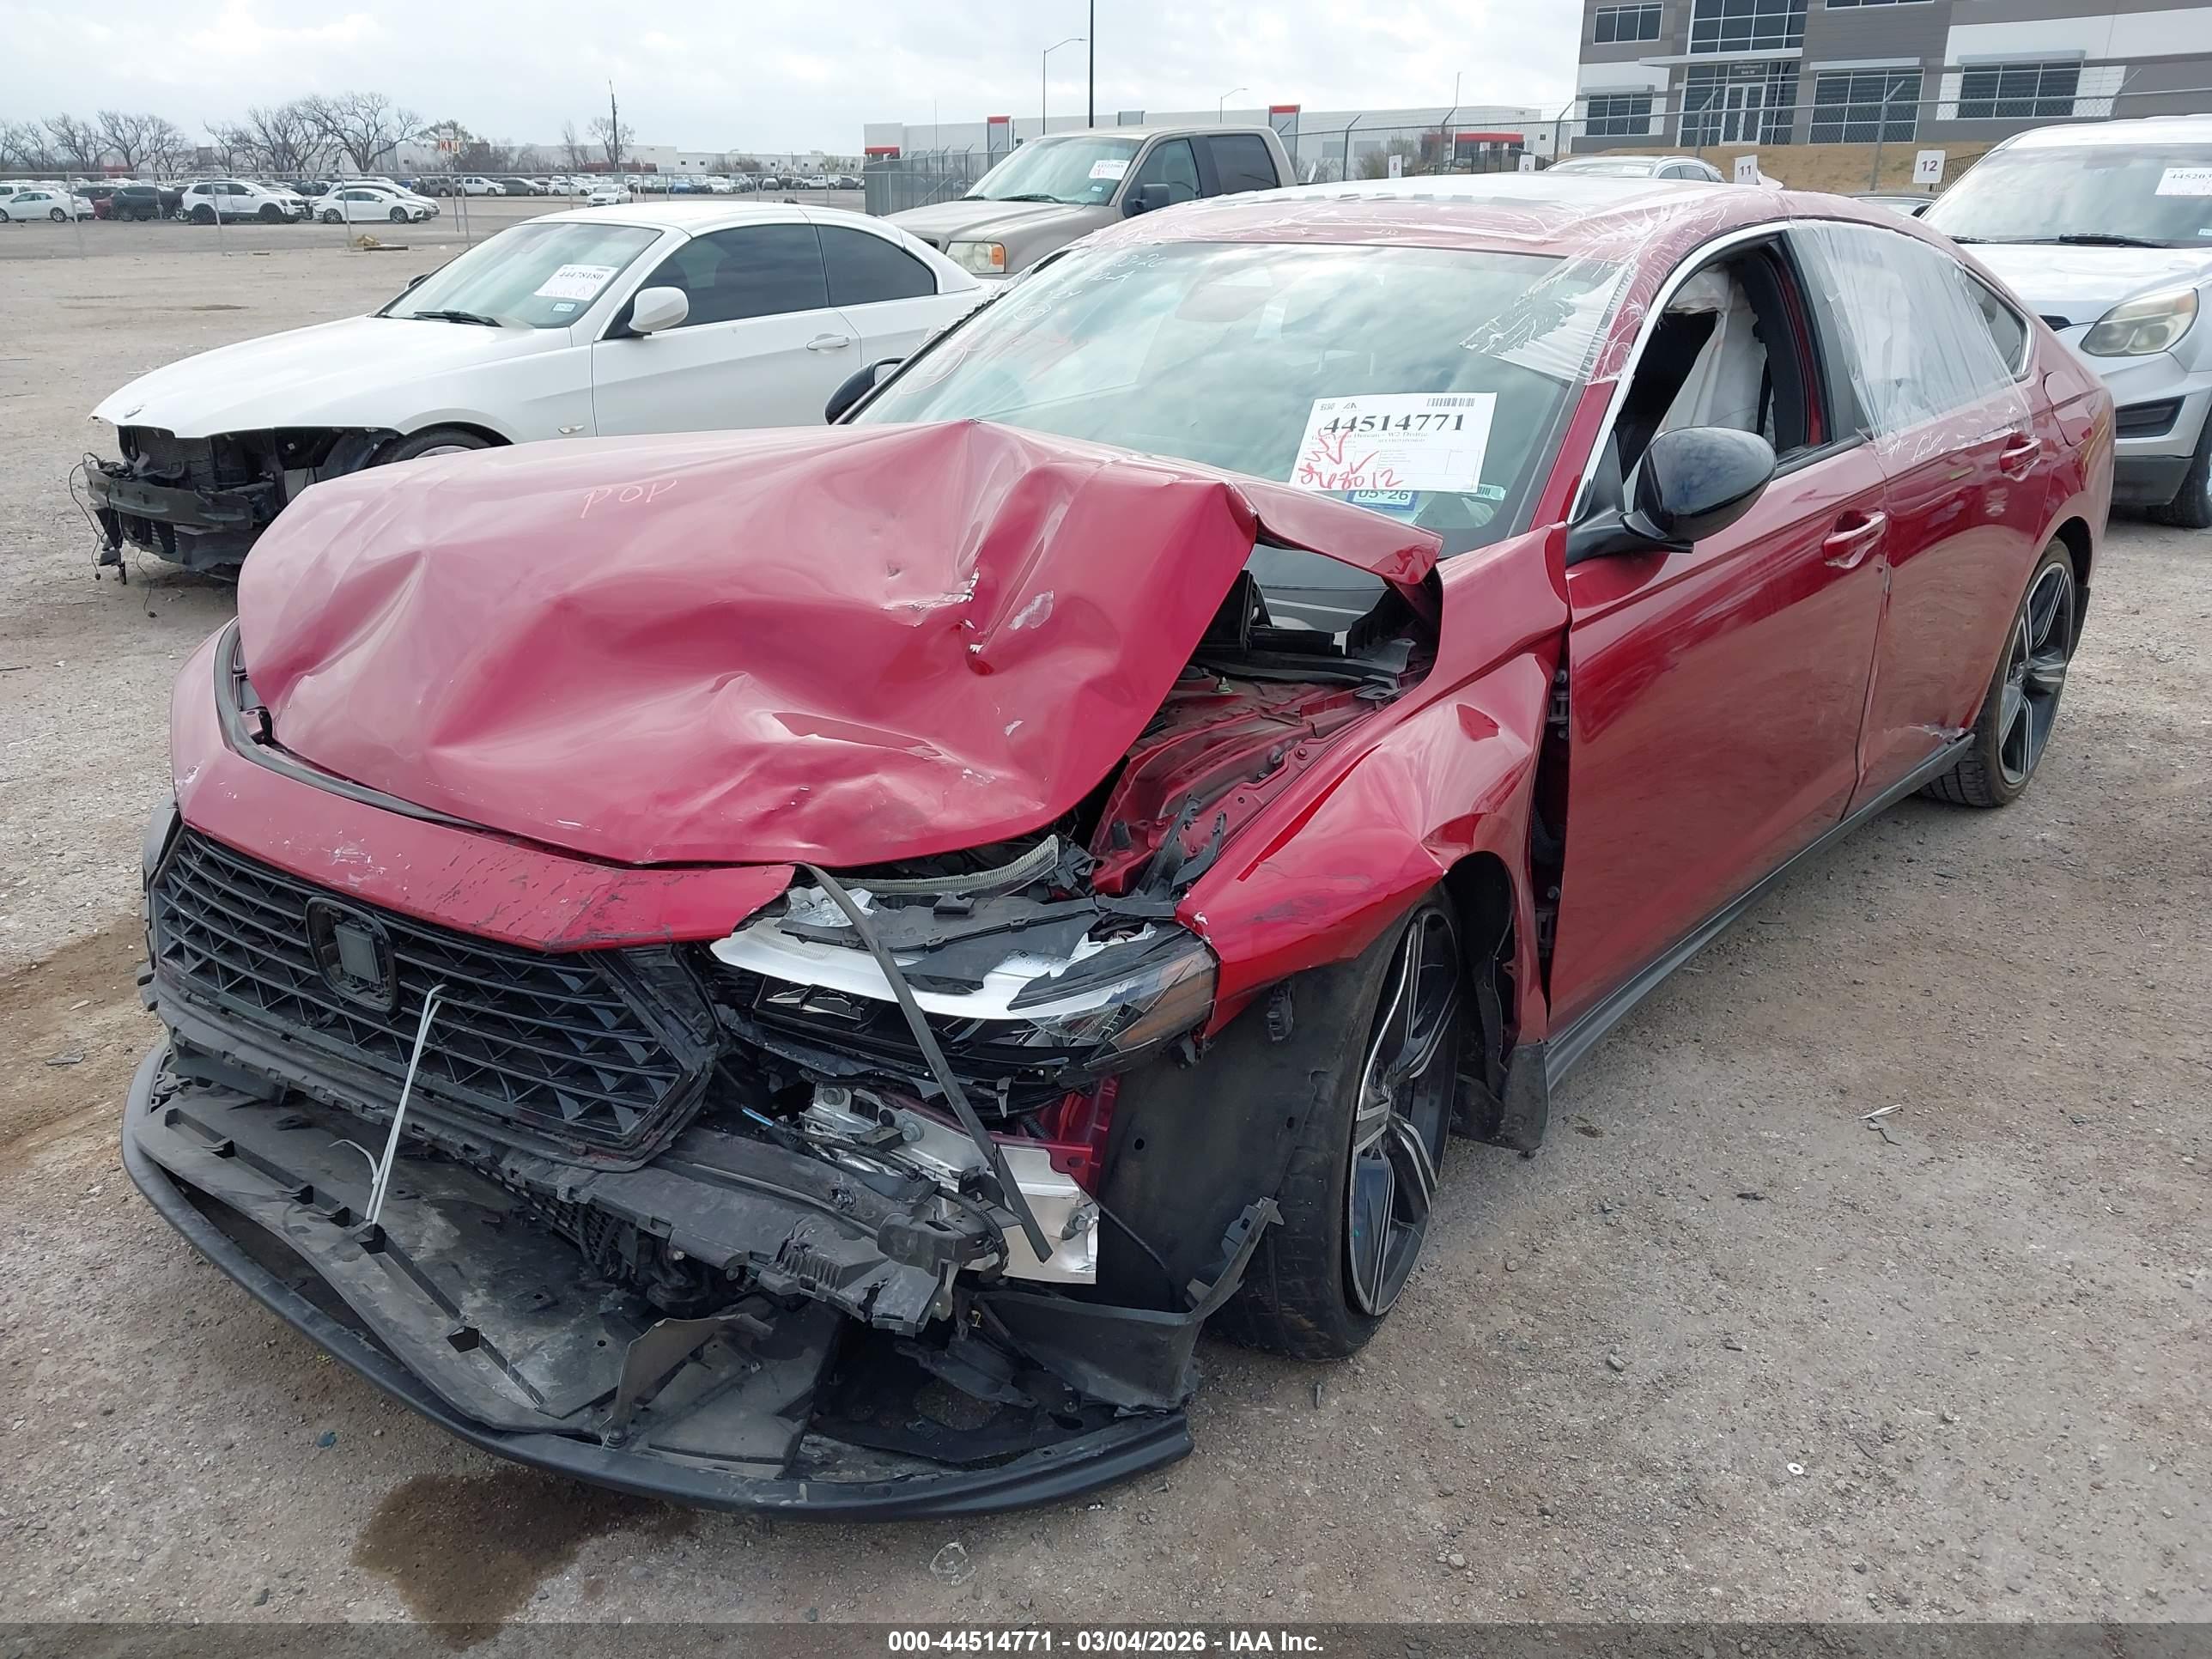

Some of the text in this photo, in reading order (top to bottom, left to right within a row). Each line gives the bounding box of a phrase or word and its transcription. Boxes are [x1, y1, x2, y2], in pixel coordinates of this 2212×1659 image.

[1740, 165, 1752, 176] 11
[1921, 161, 1938, 172] 12
[1324, 413, 1465, 433] 44514771
